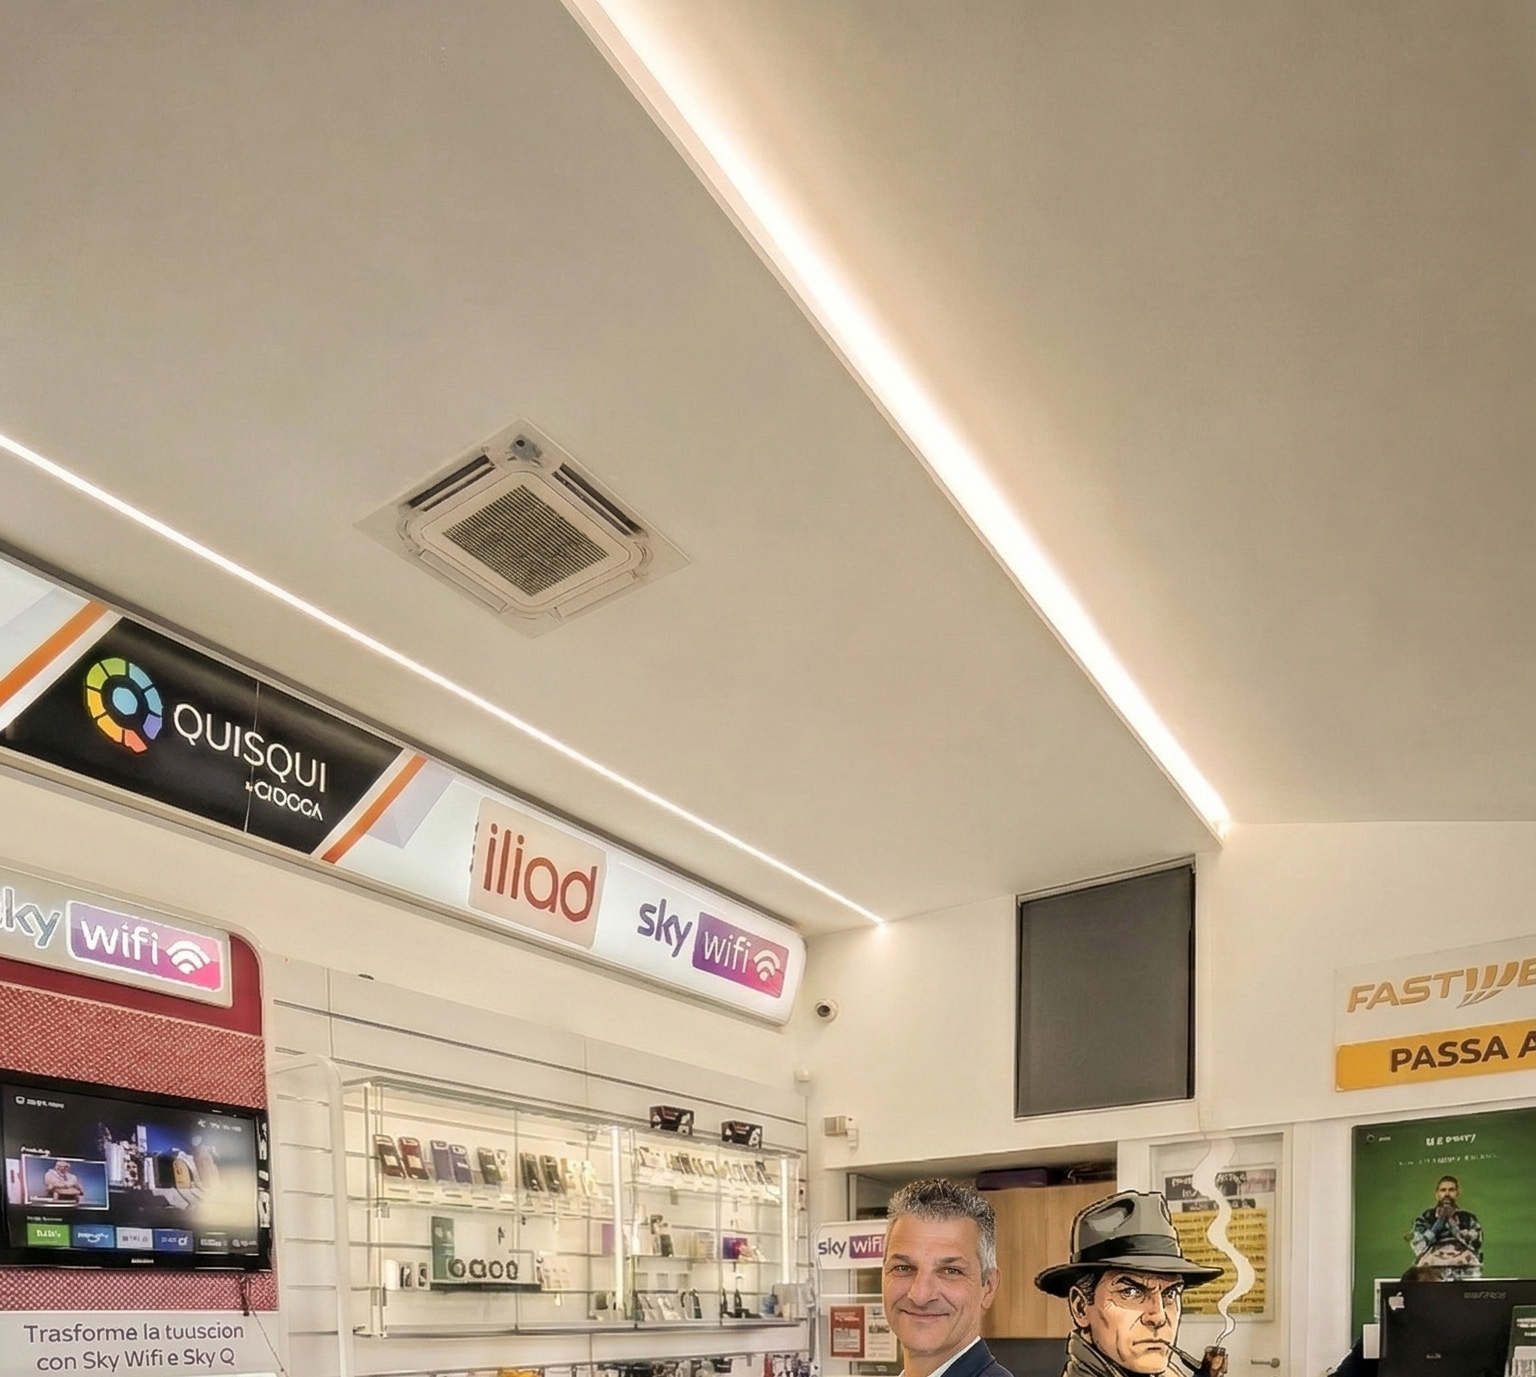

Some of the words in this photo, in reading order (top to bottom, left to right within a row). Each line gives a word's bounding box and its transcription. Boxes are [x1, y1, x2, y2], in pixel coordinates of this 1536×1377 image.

[174, 703, 325, 793] QUISQUI
[483, 823, 598, 923] iliad
[0, 887, 61, 948] ky
[80, 917, 159, 965] wifi
[637, 899, 693, 958] sky
[704, 930, 752, 973] wifi
[1390, 1035, 1509, 1073] PASSA
[818, 1237, 847, 1259] sky
[24, 1323, 138, 1343] Trasforme
[144, 1323, 160, 1341] la
[165, 1321, 244, 1340] tuuscion
[36, 1354, 77, 1371] con
[83, 1351, 120, 1372] Sky
[124, 1349, 163, 1367] Wifi
[167, 1352, 179, 1366] e
[183, 1347, 216, 1368] Sky
[219, 1347, 235, 1366] Q
